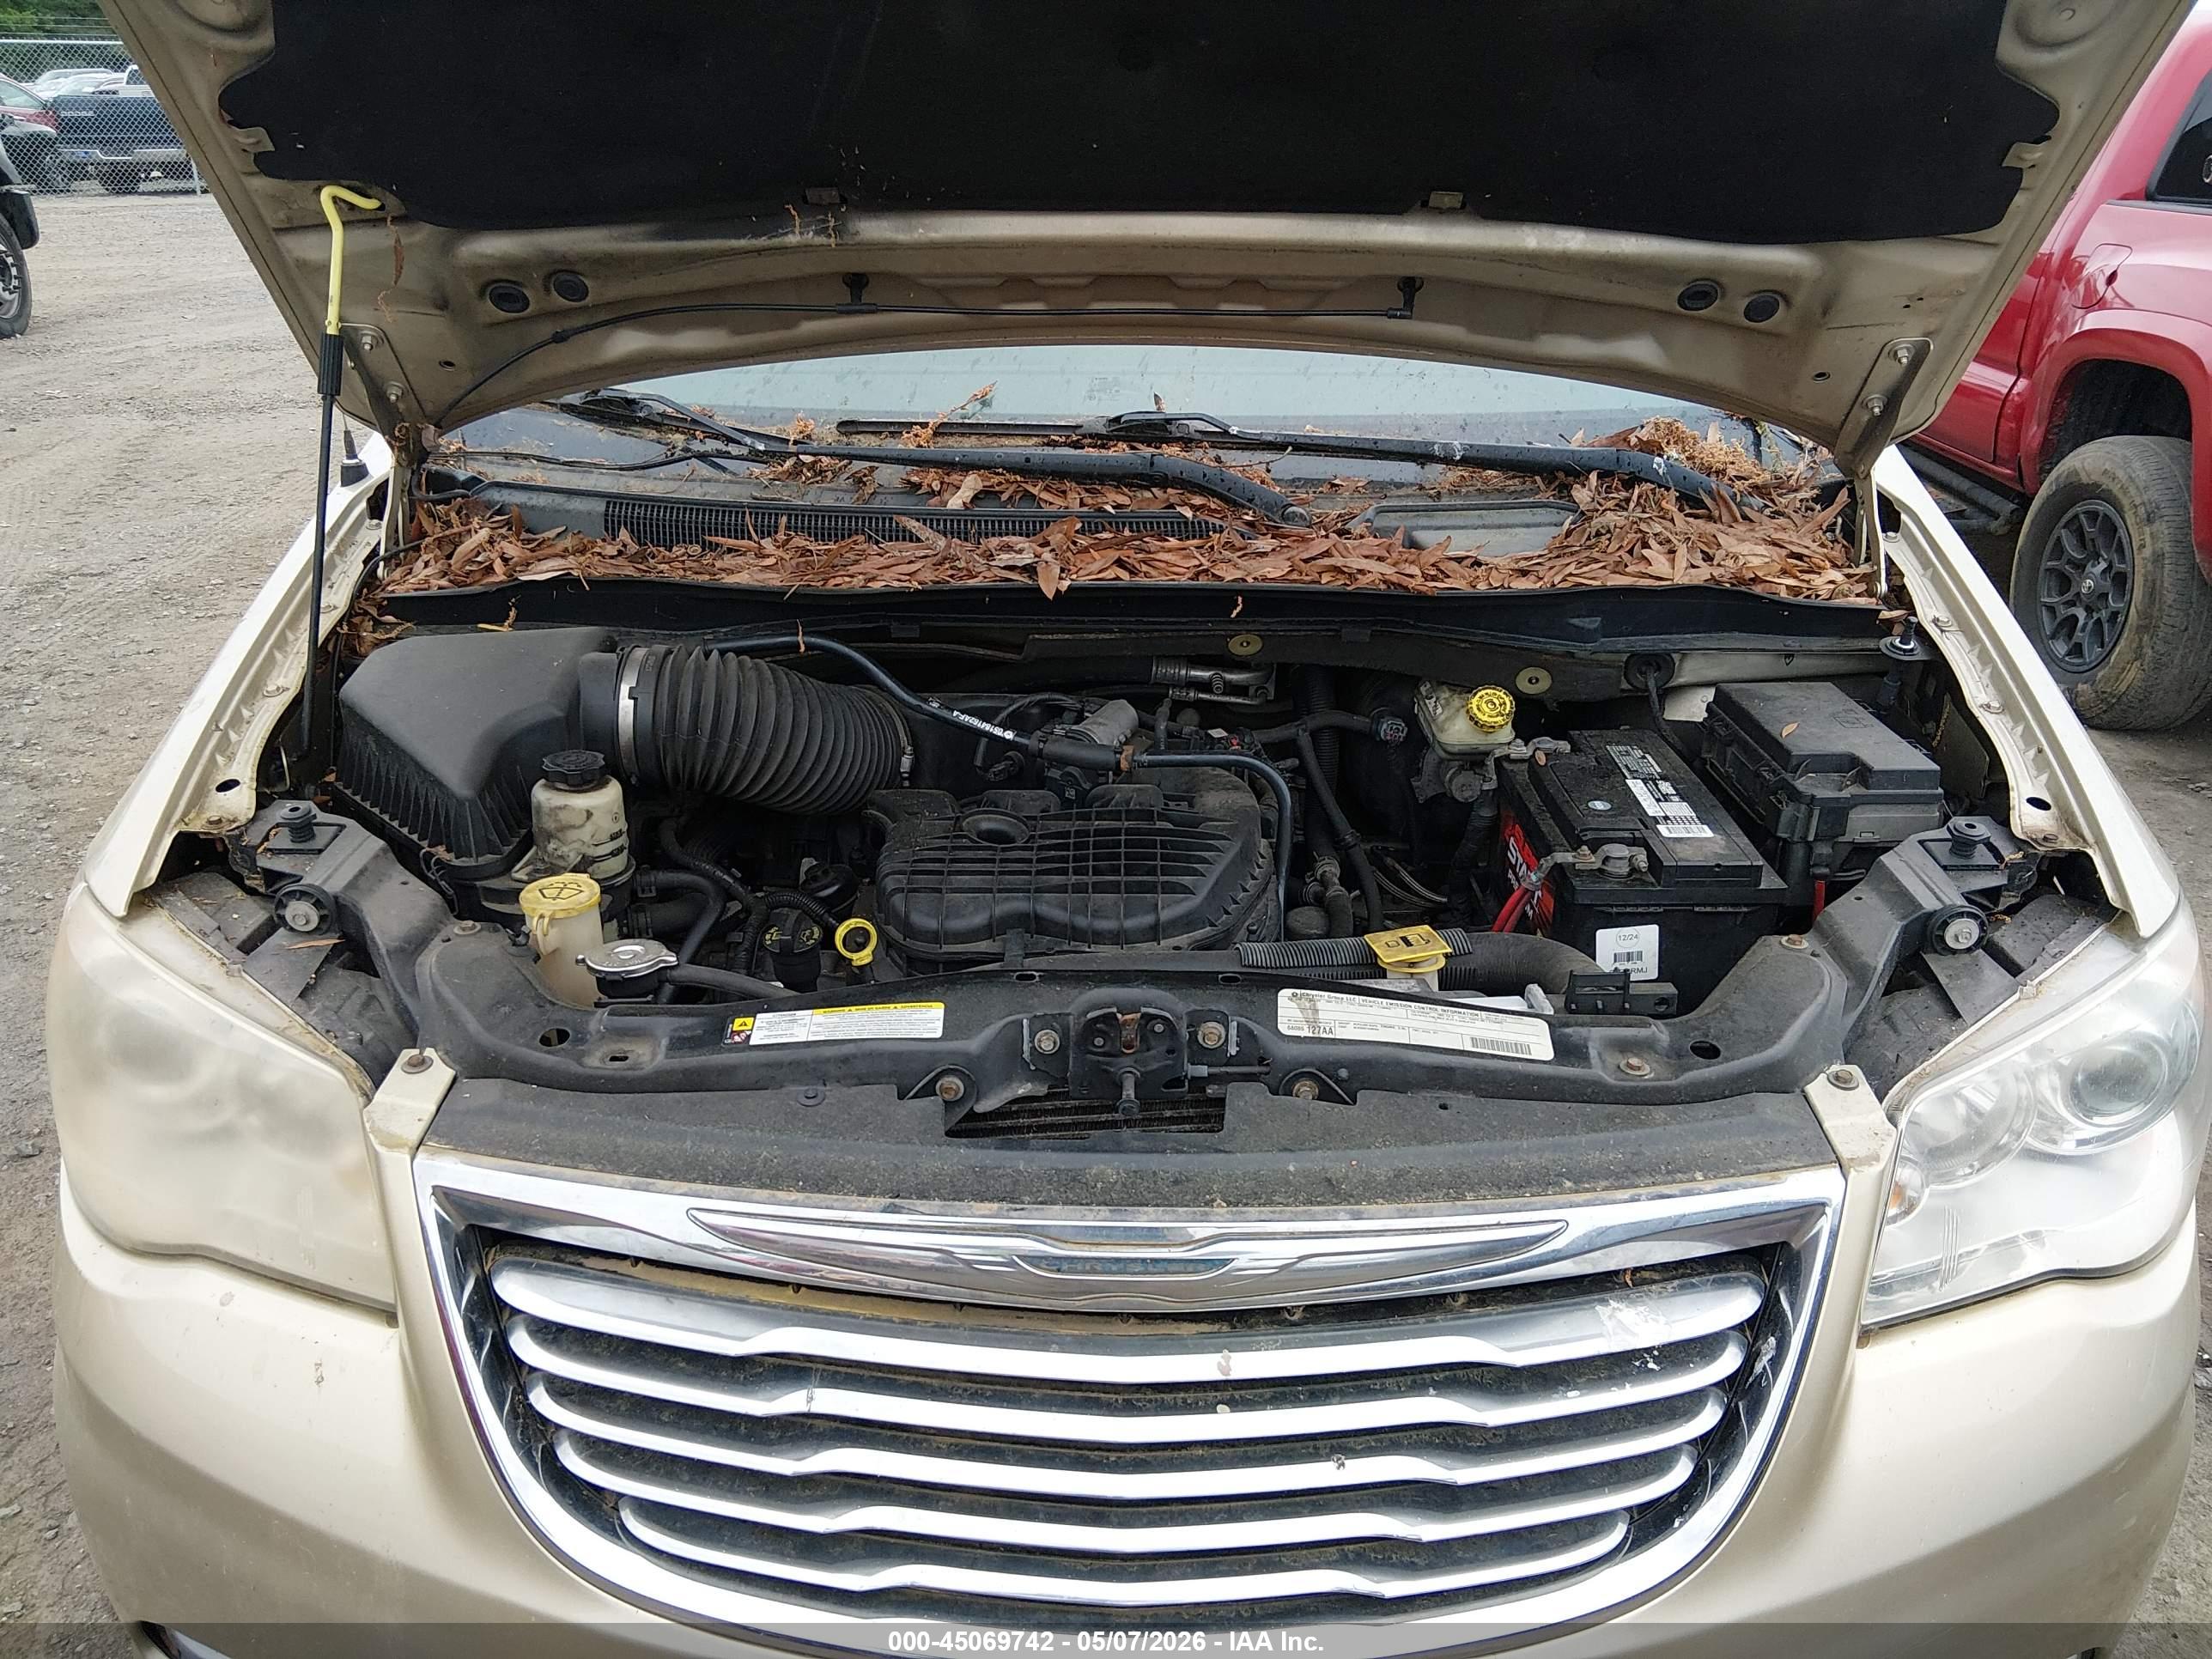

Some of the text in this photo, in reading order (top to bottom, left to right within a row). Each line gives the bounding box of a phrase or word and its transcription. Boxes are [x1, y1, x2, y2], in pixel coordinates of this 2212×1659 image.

[1619, 933, 1638, 942] 12/24
[1302, 992, 1326, 1000] Chrysler
[1327, 994, 1345, 1002] Group
[1385, 1000, 1413, 1010] EMISSION
[1413, 1004, 1439, 1012] CONTROL
[1440, 1008, 1480, 1018] INFORMATION
[1306, 1024, 1334, 1036] 127AA
